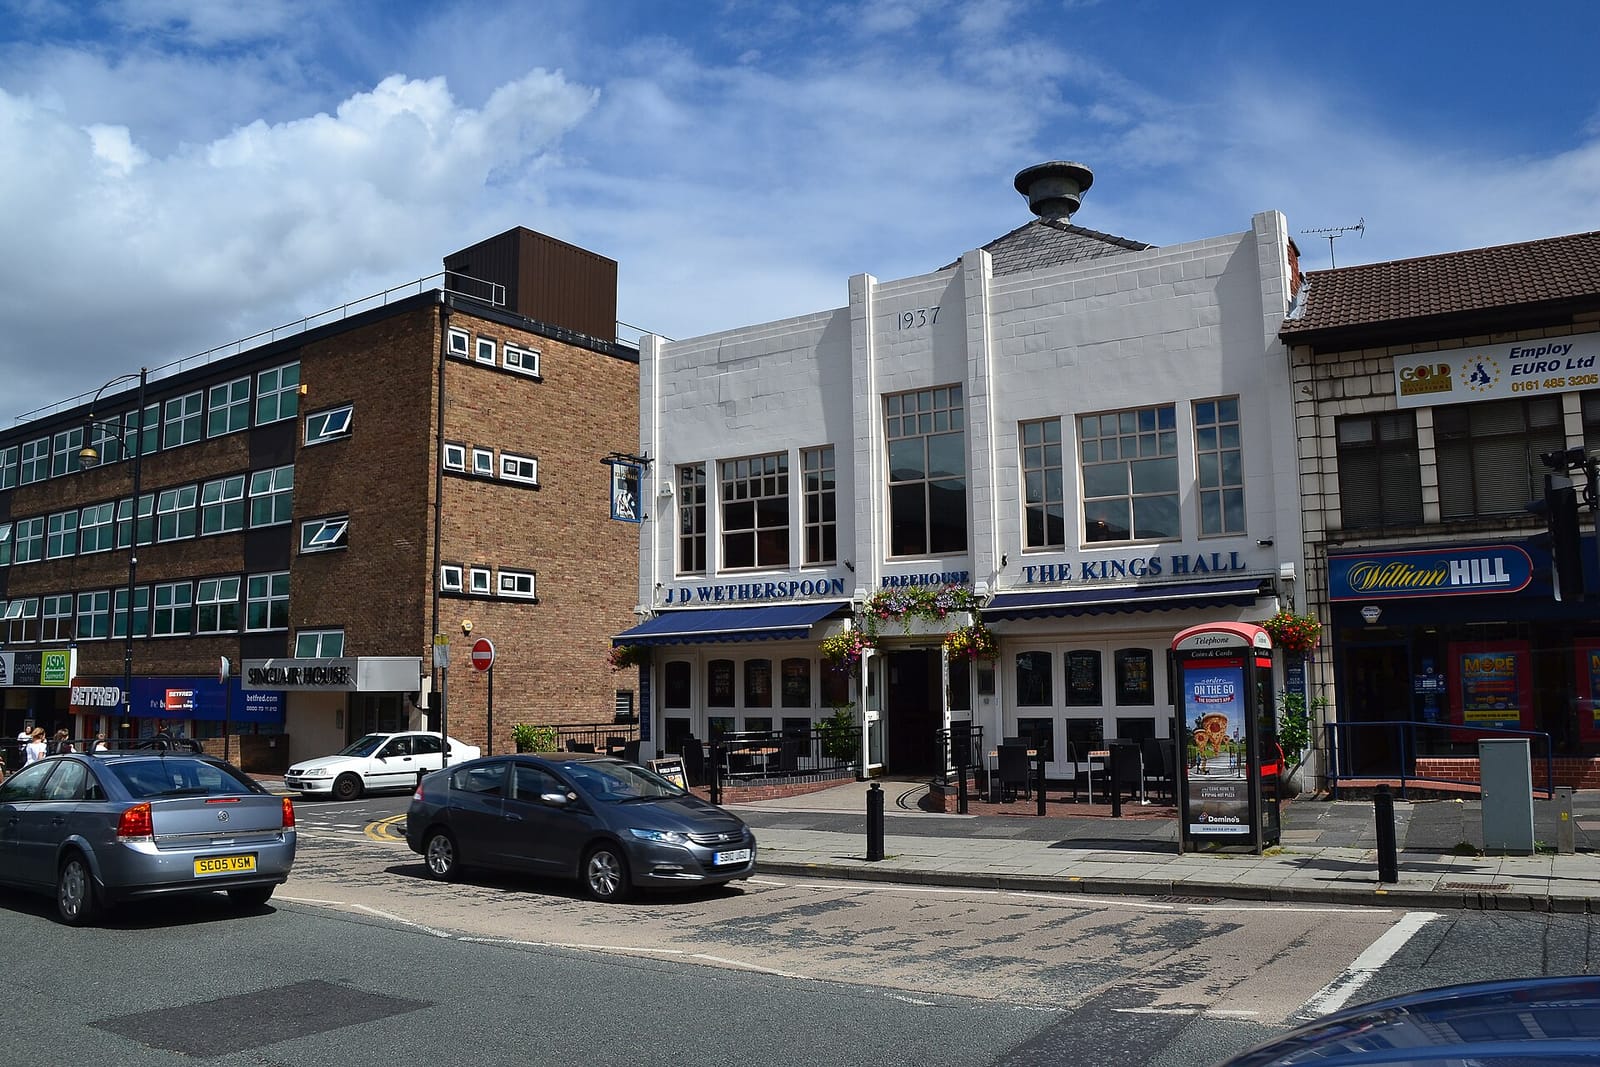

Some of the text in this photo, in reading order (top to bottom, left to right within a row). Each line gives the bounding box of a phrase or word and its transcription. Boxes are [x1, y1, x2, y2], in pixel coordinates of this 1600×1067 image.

[898, 306, 941, 330] 1937
[1509, 343, 1573, 360] Employ
[1400, 363, 1452, 382] GOLD
[1511, 355, 1596, 377] EURO Ltd
[1511, 374, 1599, 392] 0161 485 3205
[1022, 551, 1246, 583] THE KINGS HALL
[1348, 557, 1510, 592] William HILL
[881, 570, 970, 588] FREEHOUSE
[665, 578, 845, 603] J D WETHERSPOON
[1194, 637, 1229, 646] Telephone
[45, 654, 65, 669] ASDA
[70, 686, 120, 706] BETFRED
[1194, 684, 1234, 695] ON THE GO
[1208, 815, 1240, 823] Domino's
[200, 857, 251, 871] SE05 VSM
